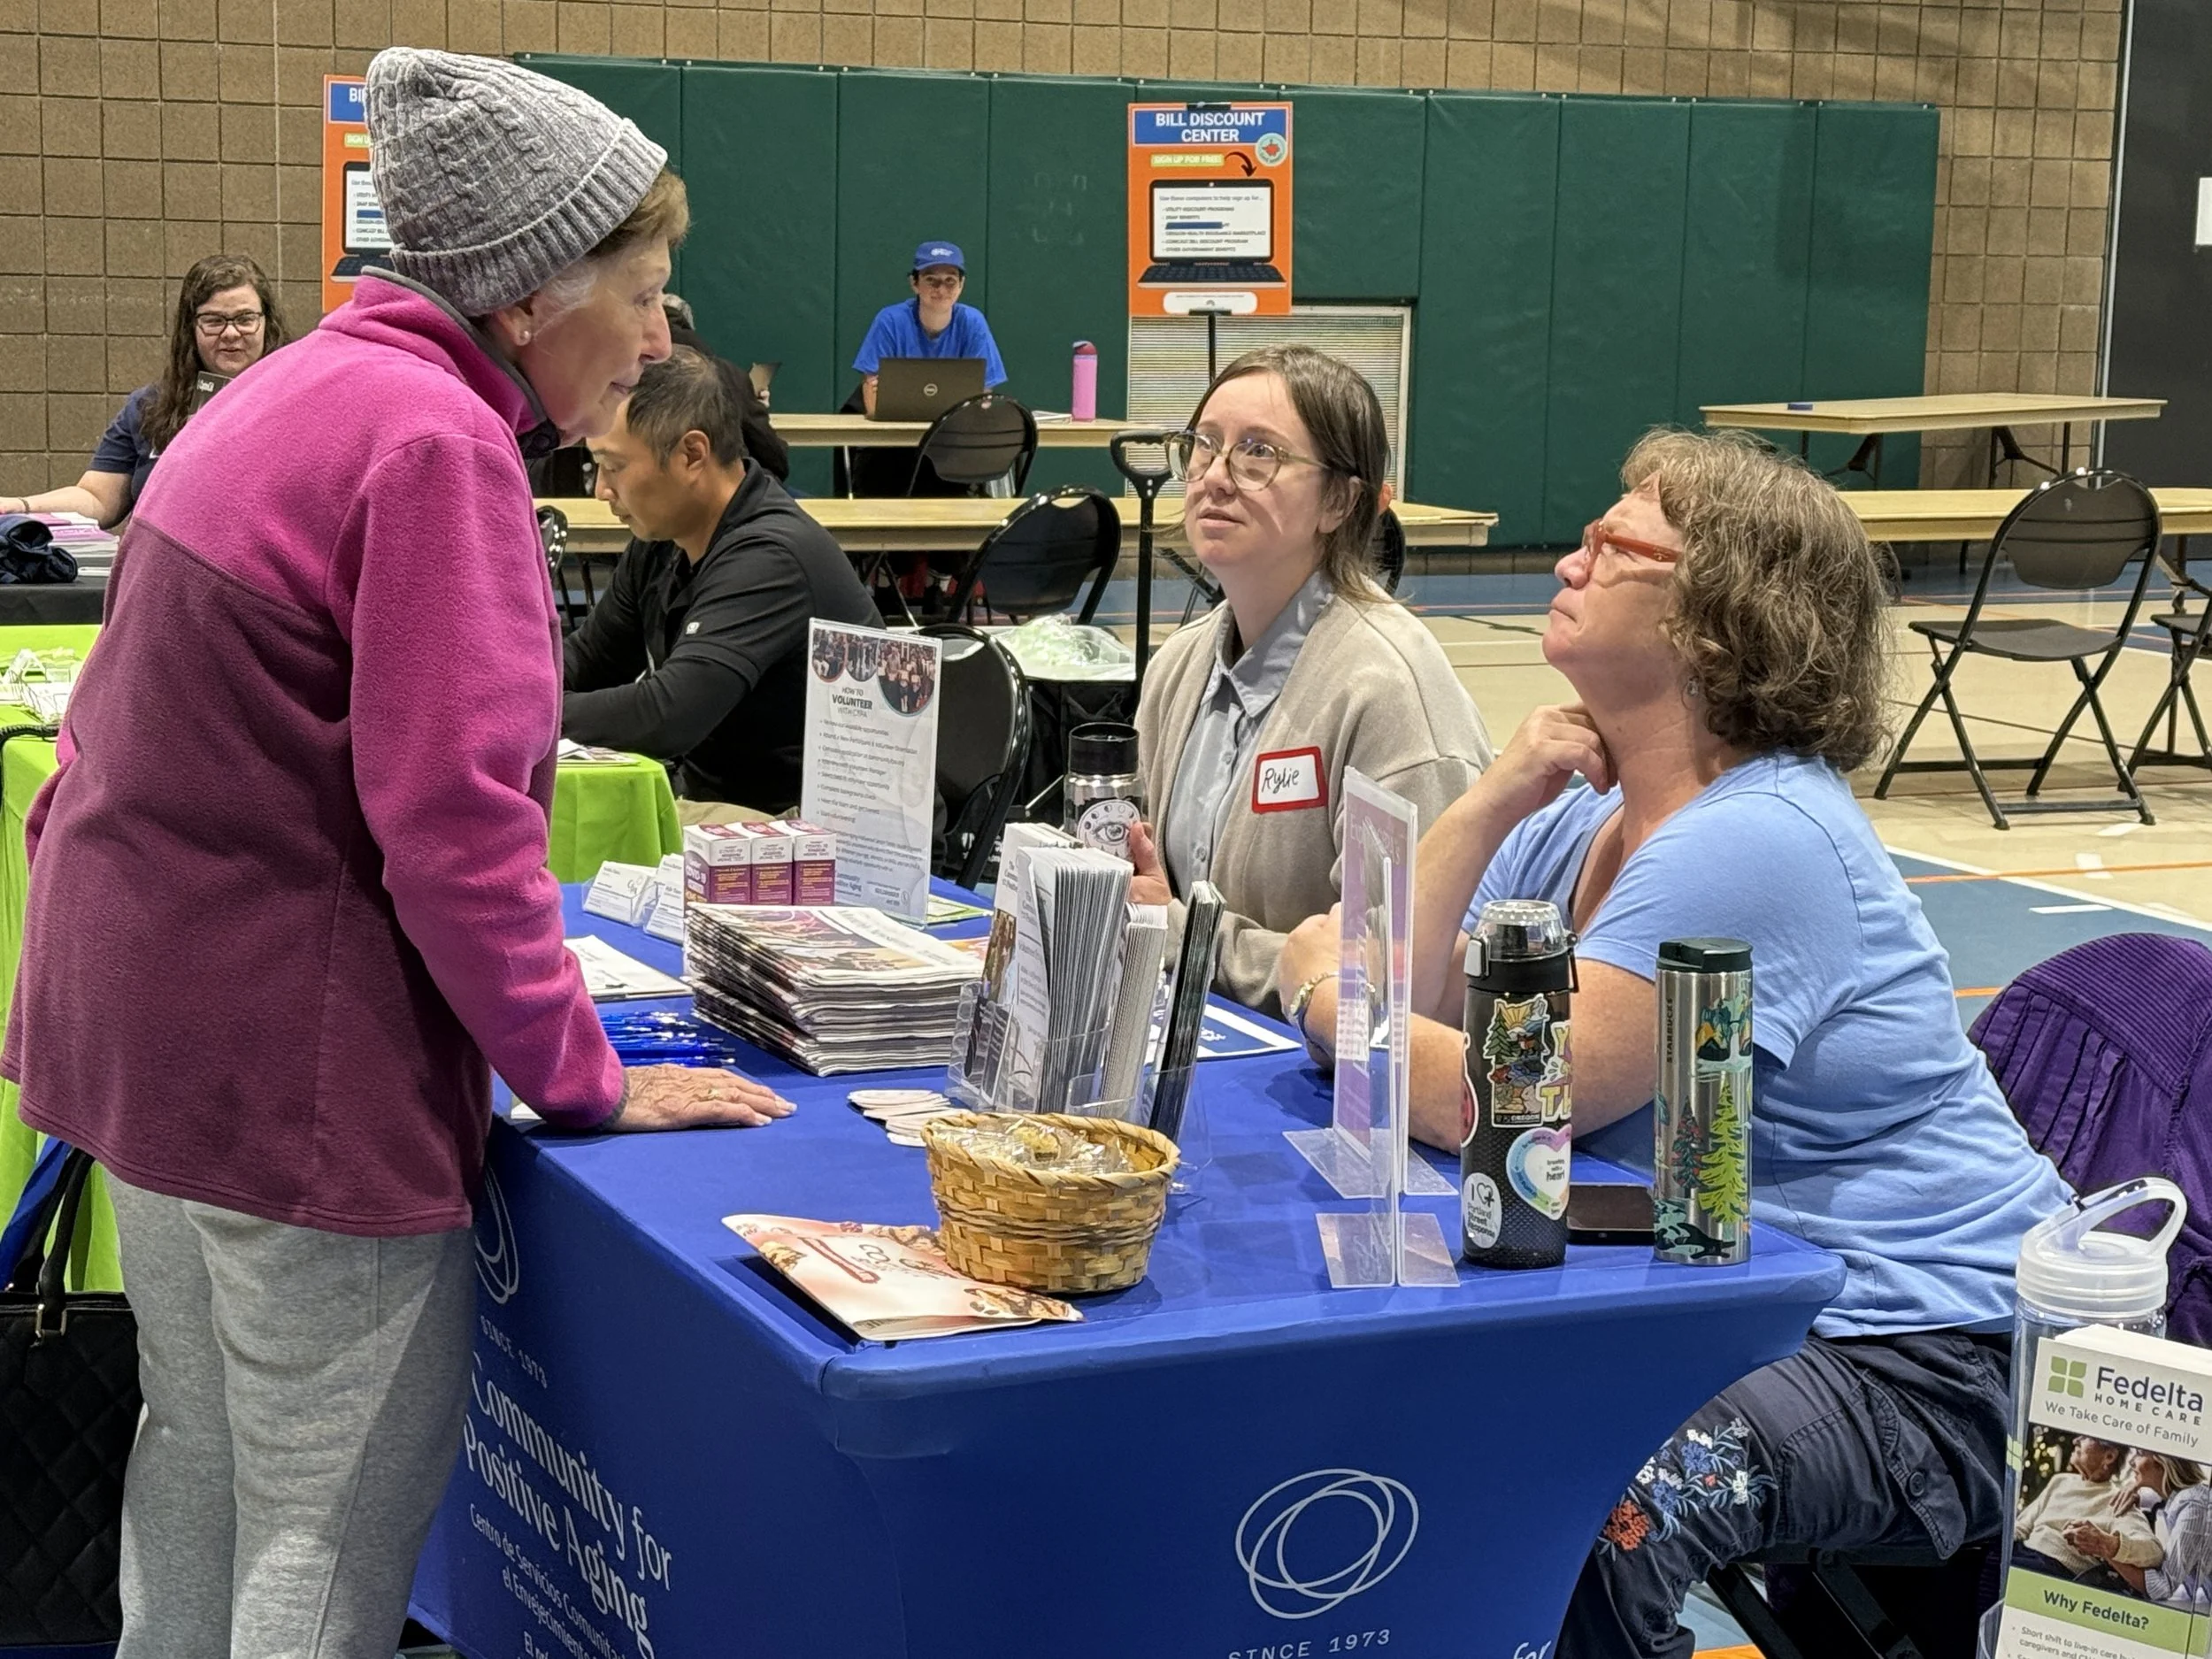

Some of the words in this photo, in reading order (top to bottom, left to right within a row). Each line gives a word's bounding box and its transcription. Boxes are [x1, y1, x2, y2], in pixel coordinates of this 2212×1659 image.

[1156, 112, 1187, 127] BILL
[1189, 112, 1265, 126] DISCOUNT
[1181, 128, 1240, 142] CENTER
[832, 694, 872, 710] VOLUNTEER
[856, 687, 864, 696] TO
[1262, 767, 1300, 794] Rylie
[1471, 1183, 1475, 1201] I
[480, 1315, 515, 1359] SINCE
[518, 1349, 547, 1388] 1973
[2096, 1366, 2204, 1413] Fedelta
[2045, 1401, 2066, 1416] We
[2070, 1406, 2098, 1424] Take
[2102, 1414, 2132, 1432] Care
[2137, 1423, 2151, 1435] of
[2154, 1425, 2199, 1448] Family
[2094, 1393, 2143, 1413] HOME
[2152, 1406, 2201, 1426] CARE
[472, 1351, 625, 1562] Community
[632, 1505, 672, 1592] for
[464, 1413, 560, 1552] Positive
[564, 1505, 655, 1659] Aging
[470, 1503, 502, 1548] Centro
[503, 1532, 516, 1563] de
[516, 1544, 562, 1609] Servicios
[502, 1565, 513, 1592] el
[2044, 1590, 2078, 1614] Why
[2082, 1601, 2149, 1631] Fedelta?
[1329, 1629, 1390, 1653] 1973
[2019, 1639, 2059, 1656] caregivers
[2021, 1626, 2043, 1640] Short
[2045, 1633, 2062, 1645] shift
[2064, 1639, 2072, 1647] to
[2074, 1641, 2098, 1655] live-in
[2101, 1649, 2118, 1659] care
